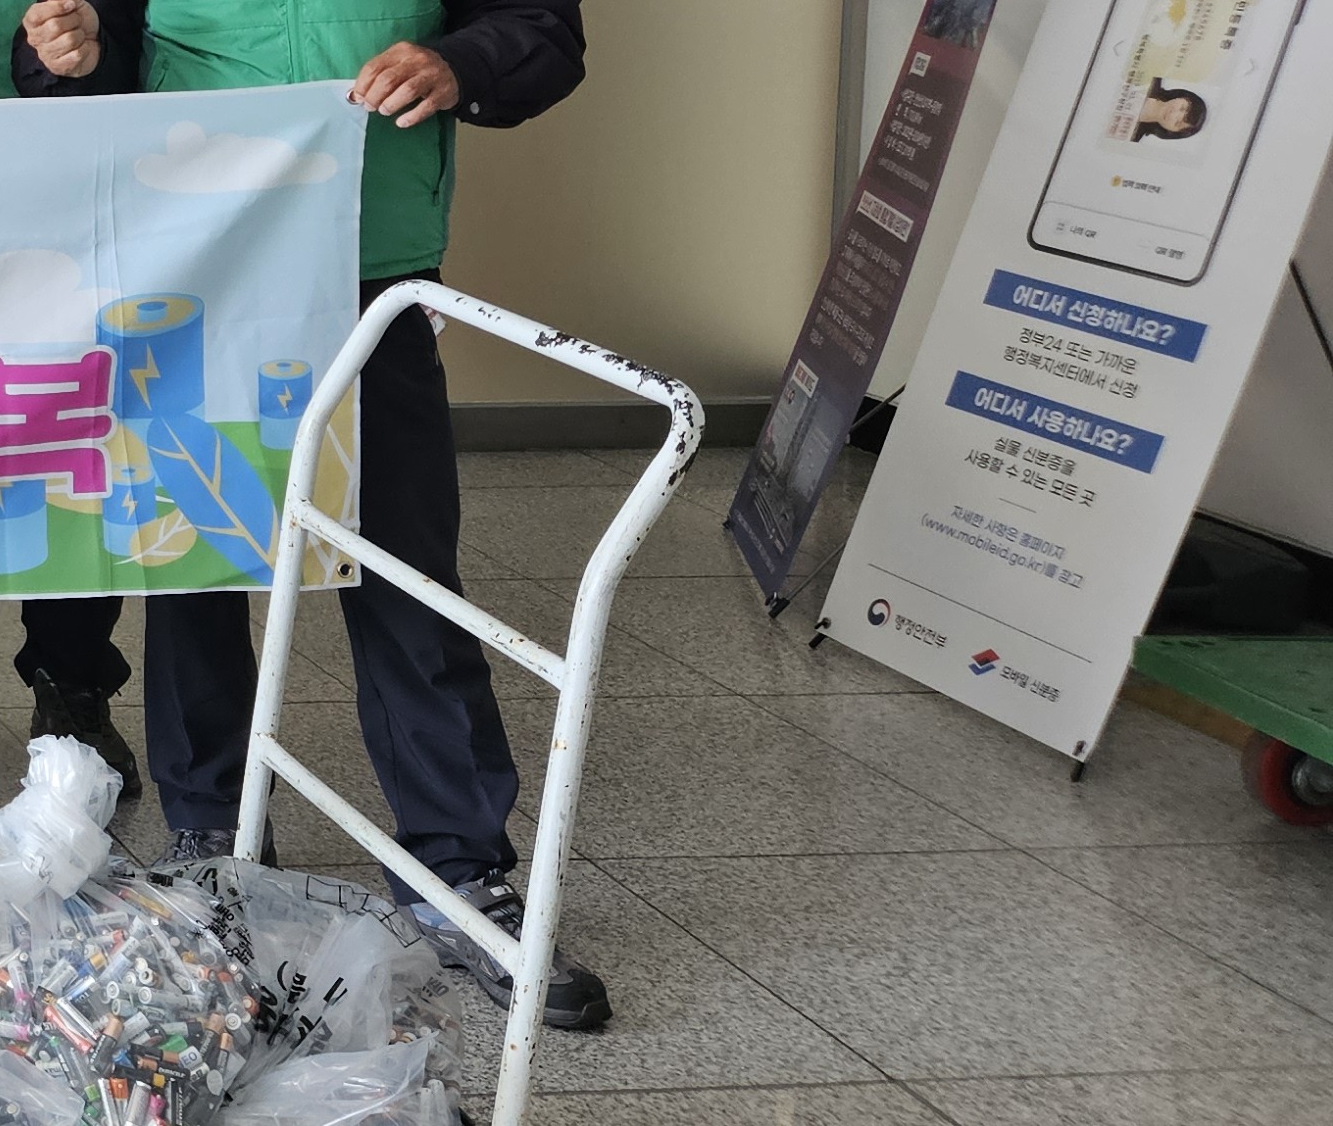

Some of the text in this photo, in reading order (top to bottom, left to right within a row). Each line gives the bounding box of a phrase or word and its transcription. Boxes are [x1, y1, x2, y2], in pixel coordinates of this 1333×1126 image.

[1013, 284, 1177, 346] 어디서 신청하나요?
[1003, 345, 1139, 399] 행정복지센터에서 신청
[1019, 327, 1138, 375] 정부24 또는 가까운
[974, 387, 1134, 455] 어디서 사용하나요?
[964, 449, 1097, 508] 사용할 수 있는 모든 곳
[994, 436, 1078, 477] 실물 신분증을
[894, 614, 948, 649] 행정안전부
[999, 665, 1062, 703] 모바일 신분증
